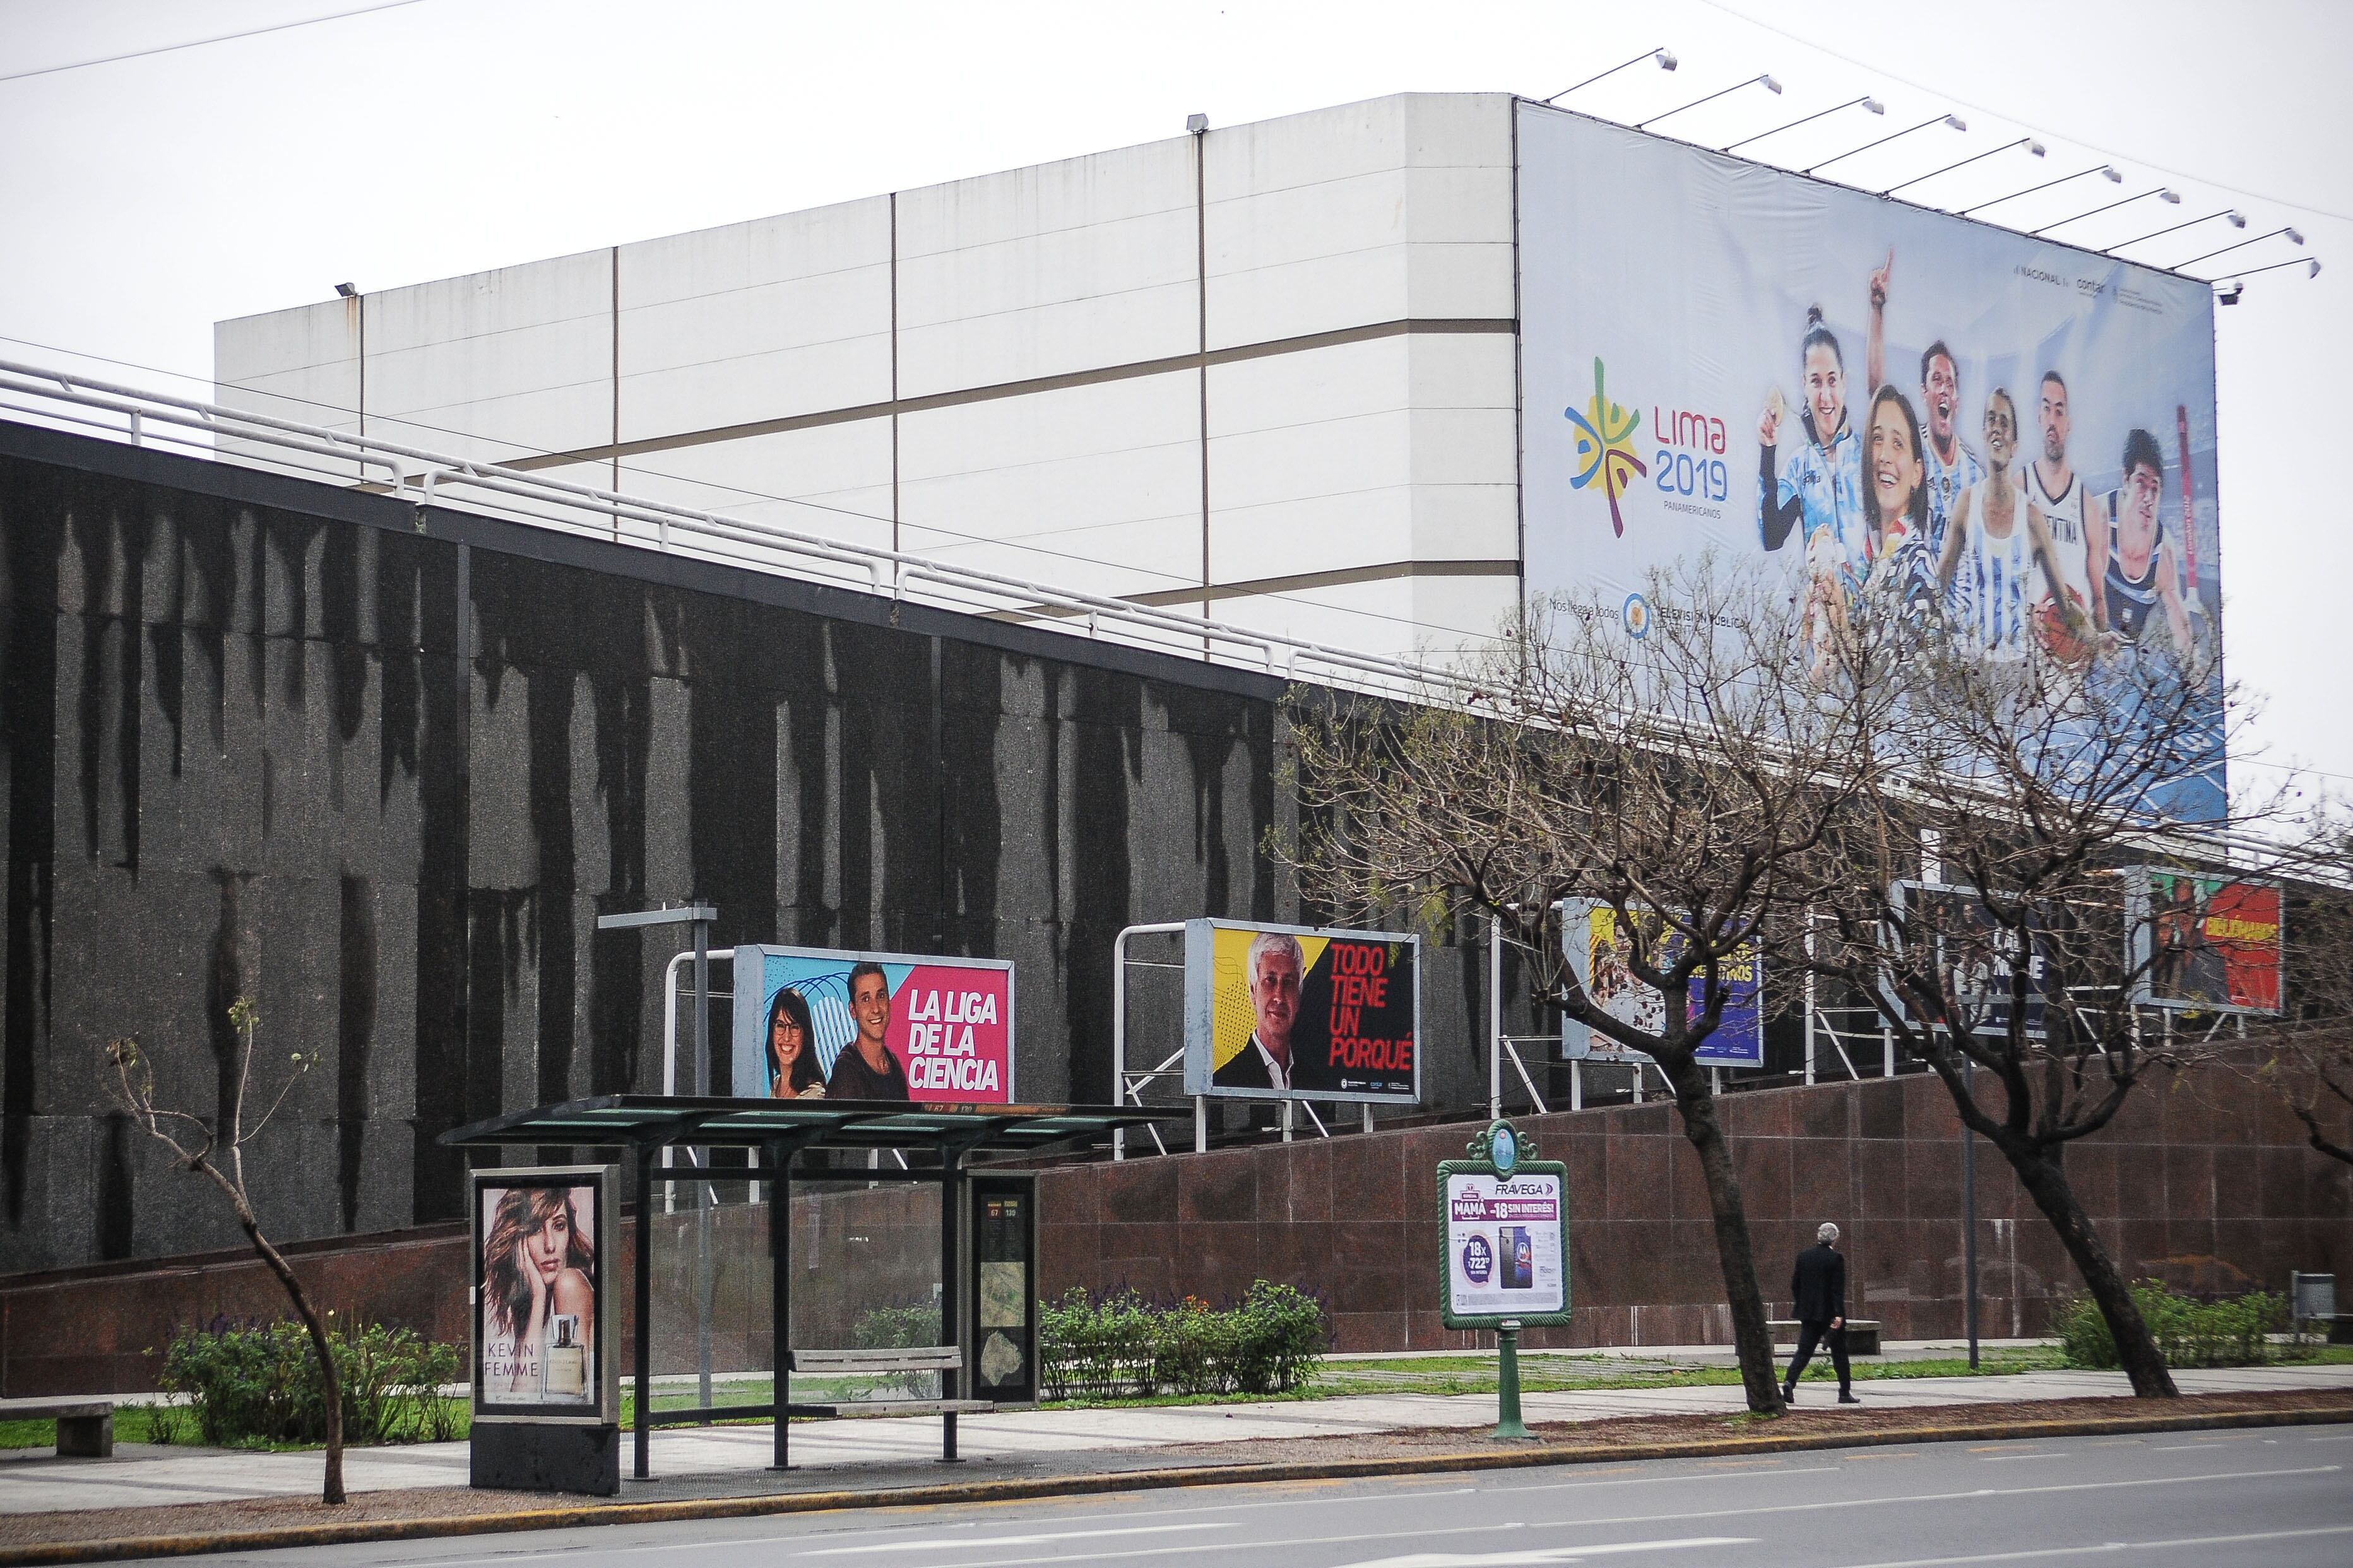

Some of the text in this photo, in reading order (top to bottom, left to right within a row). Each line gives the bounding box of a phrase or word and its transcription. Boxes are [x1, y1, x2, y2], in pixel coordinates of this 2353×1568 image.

[2021, 266, 2061, 286] NACIONAL
[1656, 450, 1728, 502] 2019
[1664, 500, 1721, 519] PANAMERICANOS
[1550, 598, 1567, 612] Nos
[1596, 606, 1619, 620] todos
[1329, 943, 1385, 976] TODO
[908, 989, 998, 1025] LA LIGA
[1329, 975, 1389, 1008] TIENE
[1329, 1006, 1360, 1037] UN
[908, 1023, 976, 1057] DE LA
[1329, 1032, 1414, 1071] PORQUÉ
[908, 1056, 999, 1092] CIENCIA
[1495, 1181, 1543, 1195] FRÁVEGA
[1454, 1197, 1486, 1215] MAMÁ
[1508, 1203, 1521, 1213] SIN
[1522, 1201, 1554, 1213] INTERÉS!
[489, 1343, 533, 1357] KEVIN
[485, 1362, 538, 1376] FEMME
